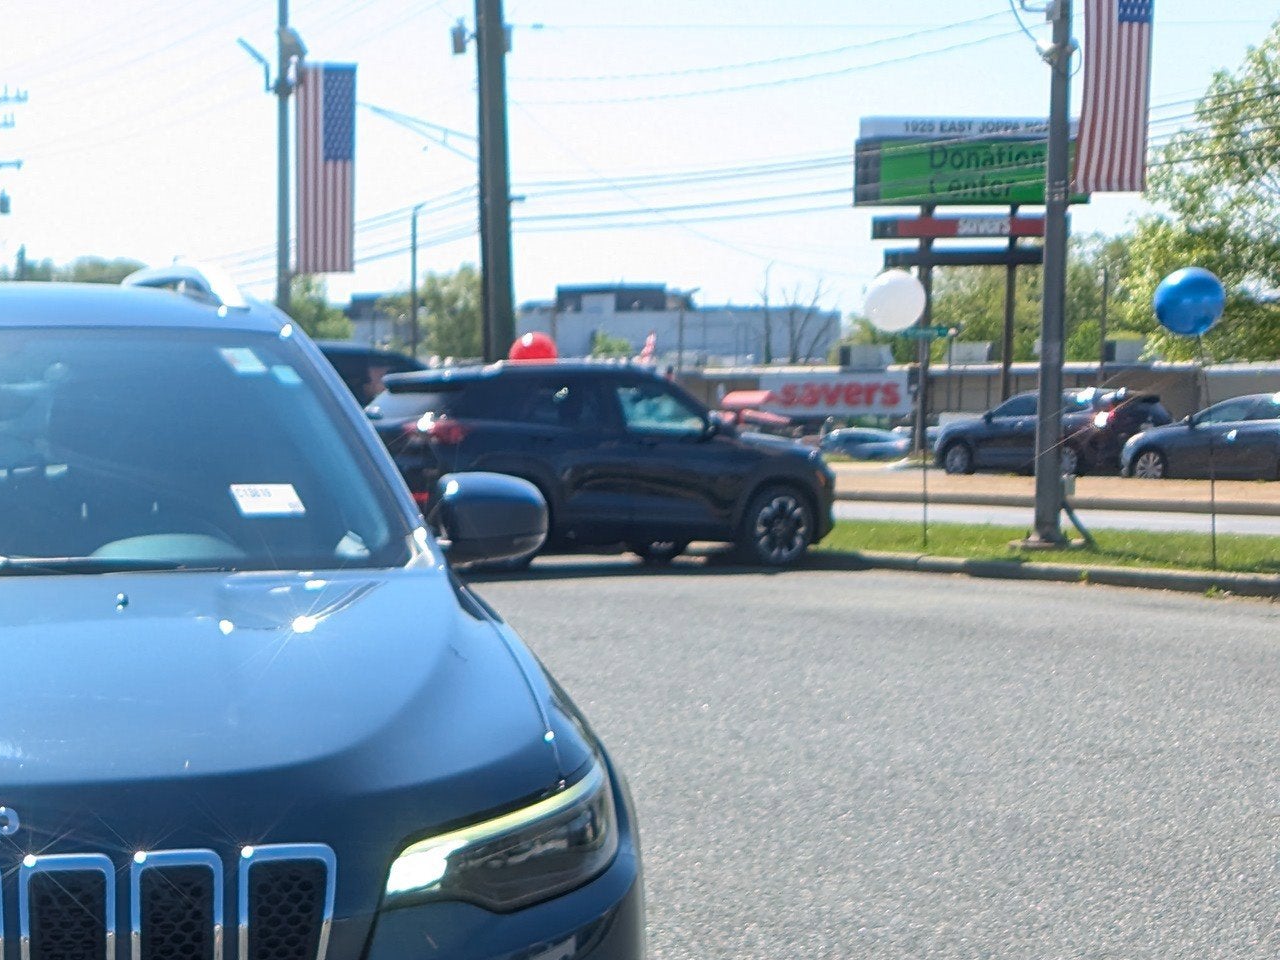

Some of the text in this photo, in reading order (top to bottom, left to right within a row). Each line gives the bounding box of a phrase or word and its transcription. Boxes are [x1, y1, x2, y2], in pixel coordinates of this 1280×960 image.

[939, 119, 972, 133] EAST
[977, 119, 1020, 134] JOPPA
[780, 381, 902, 408] savers
